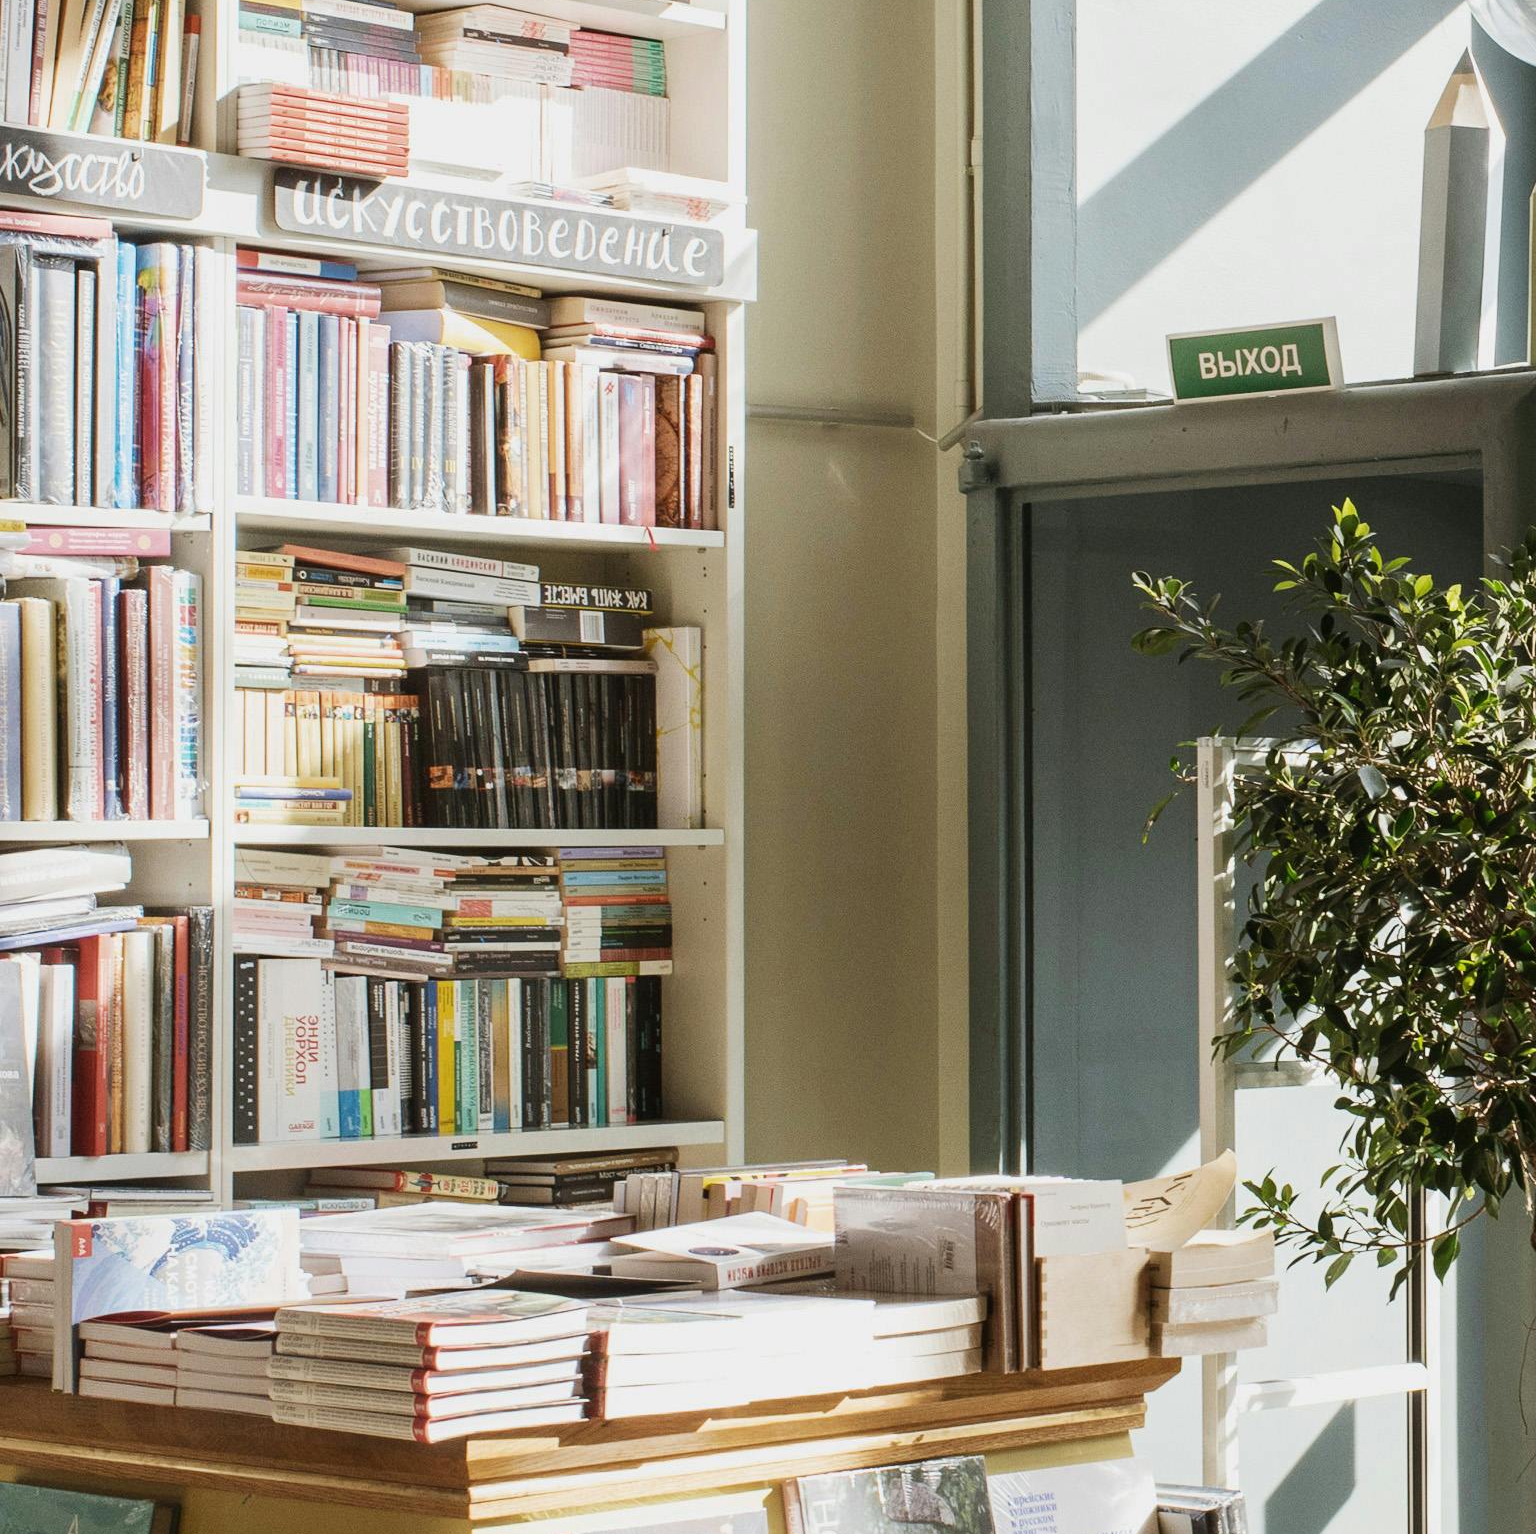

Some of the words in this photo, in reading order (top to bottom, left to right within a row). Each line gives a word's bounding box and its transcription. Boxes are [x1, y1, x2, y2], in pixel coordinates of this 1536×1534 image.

[121, 2, 132, 55] ИСКУССТВО
[293, 174, 711, 280] искусствоведение
[1198, 343, 1302, 380] ВЫХОД
[18, 377, 26, 438] SUPREMATISM
[417, 552, 449, 565] ВАСИЛИЙ
[451, 557, 497, 572] КАНДИНСКИЙ
[544, 584, 589, 607] ВМЕСТЕ
[591, 589, 623, 608] ЖИТЬ
[626, 591, 648, 609] КАК
[284, 1016, 295, 1097] ДНЕВНИКИ
[295, 1016, 307, 1085] УОРХОЛ
[308, 1016, 319, 1063] ЭНДИ
[288, 1122, 315, 1131] GARAGE
[1019, 1515, 1055, 1530] русском
